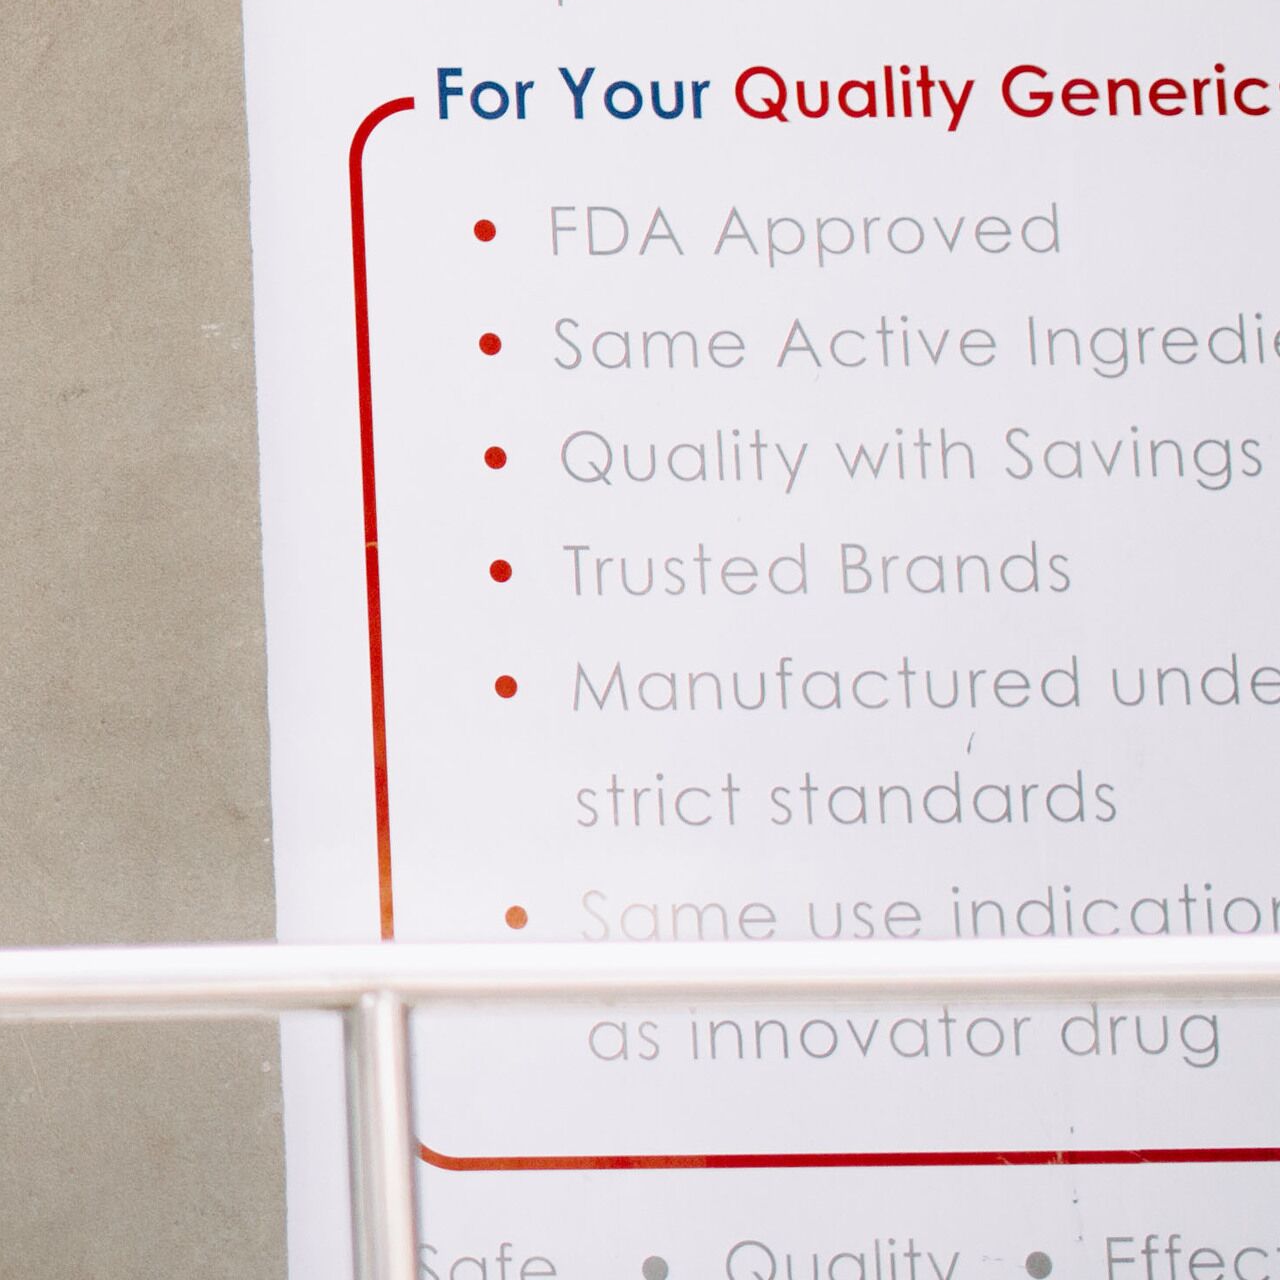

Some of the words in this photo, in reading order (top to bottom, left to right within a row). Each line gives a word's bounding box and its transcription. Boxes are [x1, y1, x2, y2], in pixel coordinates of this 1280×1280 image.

[436, 66, 535, 121] For
[560, 66, 712, 121] Your
[734, 64, 976, 132] Quality
[1002, 63, 1280, 120] Generic
[550, 206, 685, 257] FDA
[714, 203, 1063, 269] Approved
[553, 317, 746, 371] Same
[776, 314, 999, 369] Active
[1028, 312, 1280, 379] Ingredi
[560, 428, 809, 495] Quality
[836, 427, 976, 482] with
[1004, 425, 1263, 491] Savings
[563, 541, 809, 597] Trusted
[842, 540, 1073, 596] Brands
[572, 656, 1080, 713] Manufactured
[576, 773, 741, 829] strict
[771, 769, 1118, 826] standards
[581, 888, 778, 942] Same
[808, 901, 924, 941] use
[588, 1016, 660, 1063] as
[691, 1006, 1031, 1061] innovator
[1061, 1001, 1223, 1069] drug
[1106, 1235, 1280, 1280] Effec
